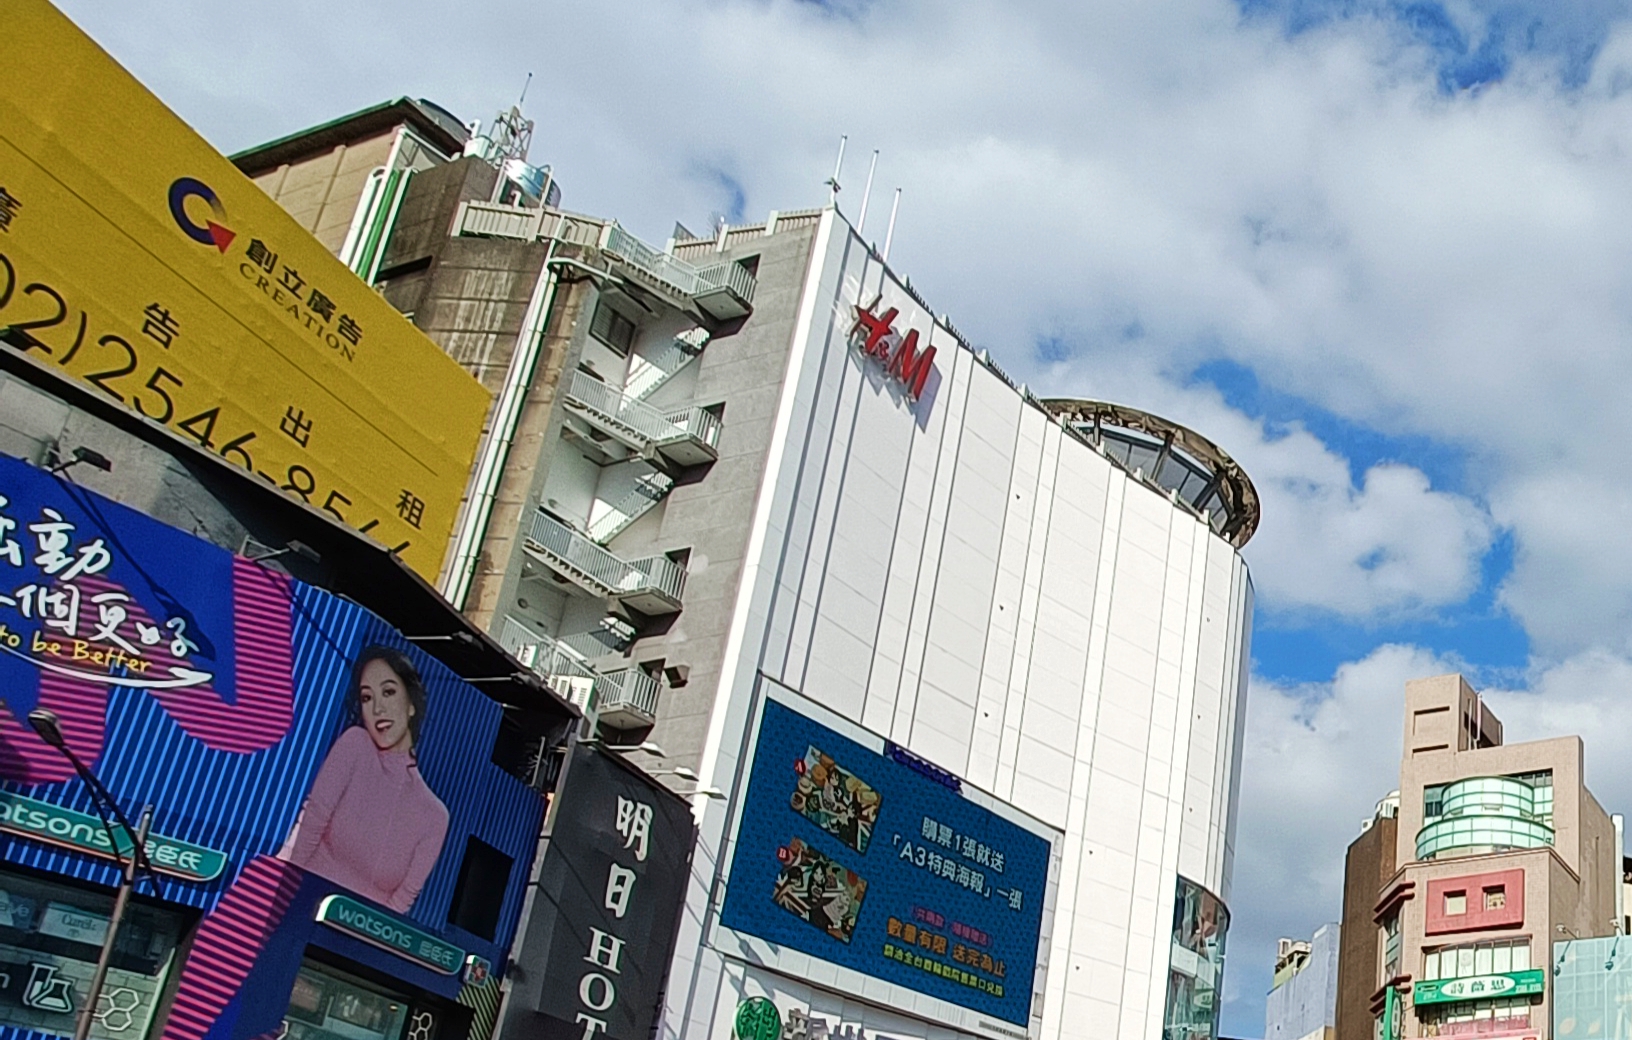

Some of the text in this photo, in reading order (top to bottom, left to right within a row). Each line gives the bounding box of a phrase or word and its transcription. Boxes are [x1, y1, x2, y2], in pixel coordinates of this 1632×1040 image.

[239, 262, 357, 363] CREATION
[245, 238, 364, 347] 創立廣告
[32, 631, 62, 656] be
[72, 639, 152, 672] Better
[606, 795, 654, 919] 明日
[338, 904, 412, 949] watsons
